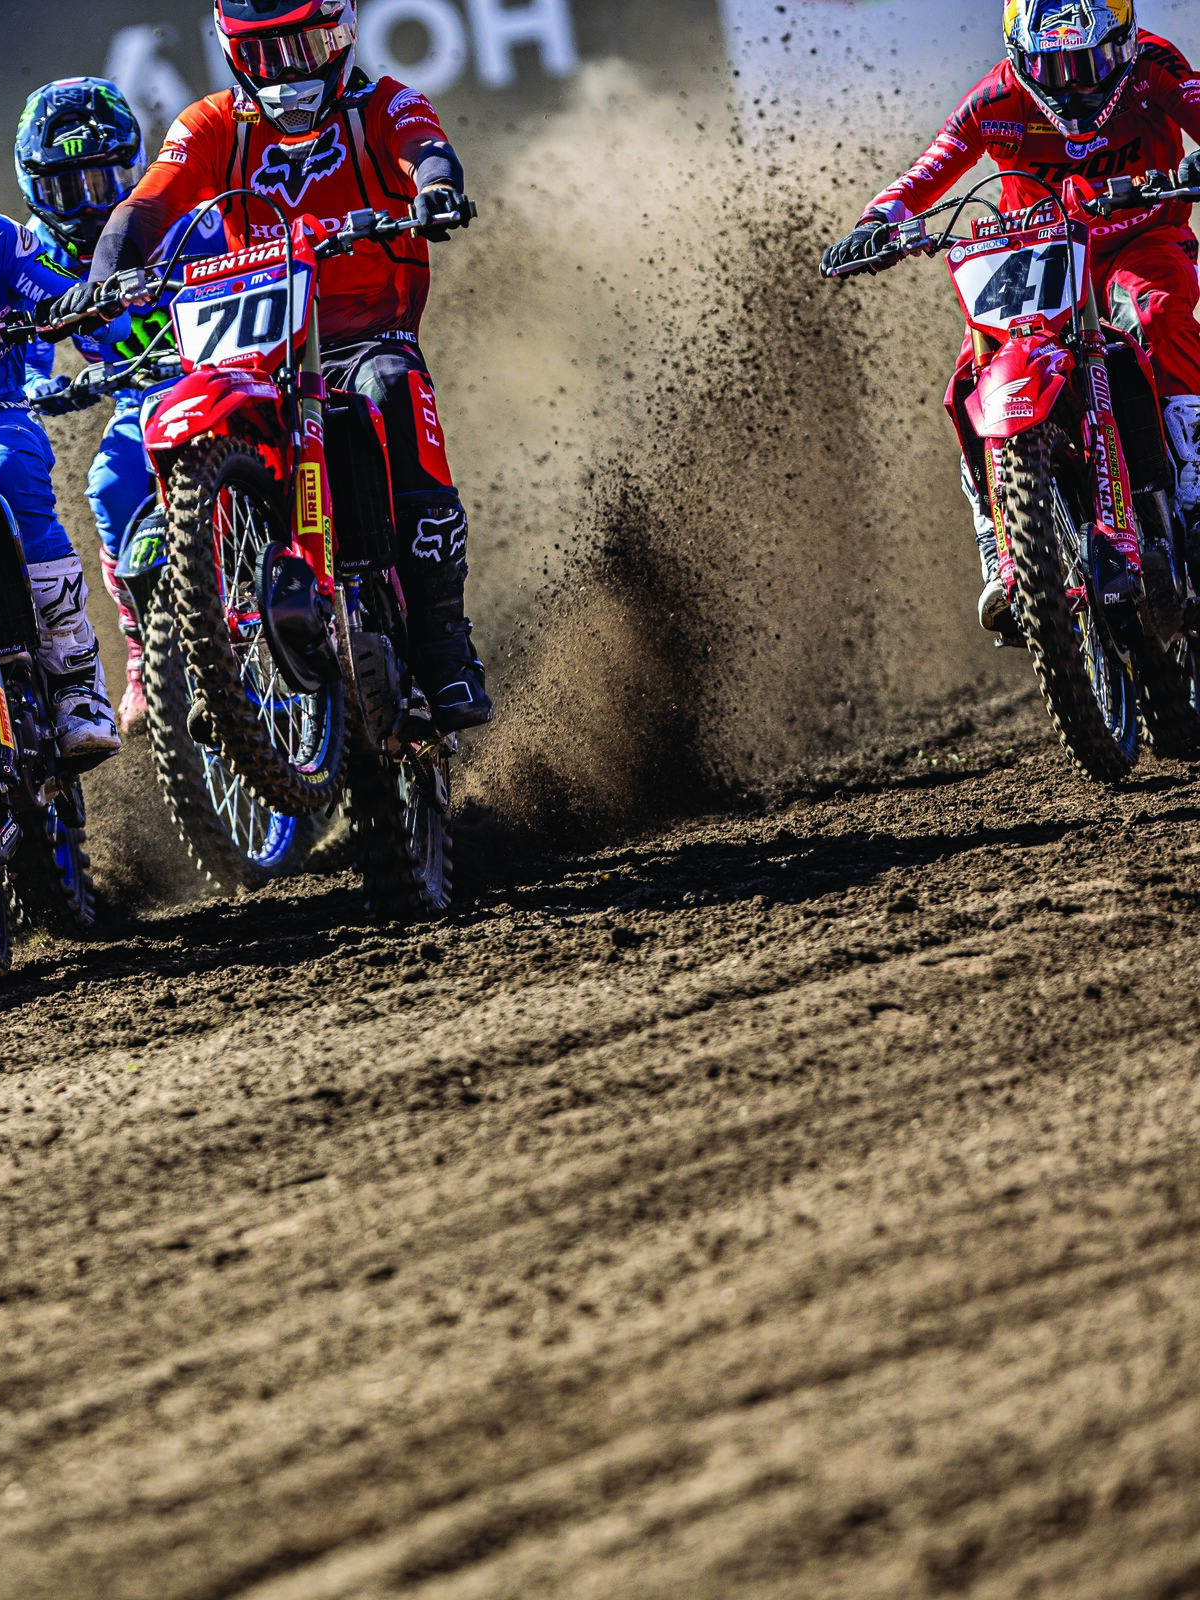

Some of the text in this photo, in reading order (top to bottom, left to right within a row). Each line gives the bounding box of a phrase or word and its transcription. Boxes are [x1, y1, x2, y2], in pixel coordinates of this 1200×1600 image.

[1041, 36, 1083, 49] Red Bull
[981, 120, 1023, 134] PARTS
[1028, 136, 1142, 184] THOR
[1091, 203, 1164, 237] ONDA
[966, 238, 1008, 254] SF GROUP
[15, 272, 53, 301] YAMA
[974, 243, 1070, 321] 41
[195, 290, 288, 366] 70
[221, 352, 259, 365] HONDA
[418, 385, 441, 447] FOX
[301, 467, 318, 528] PIRELLI
[358, 559, 372, 567] Air
